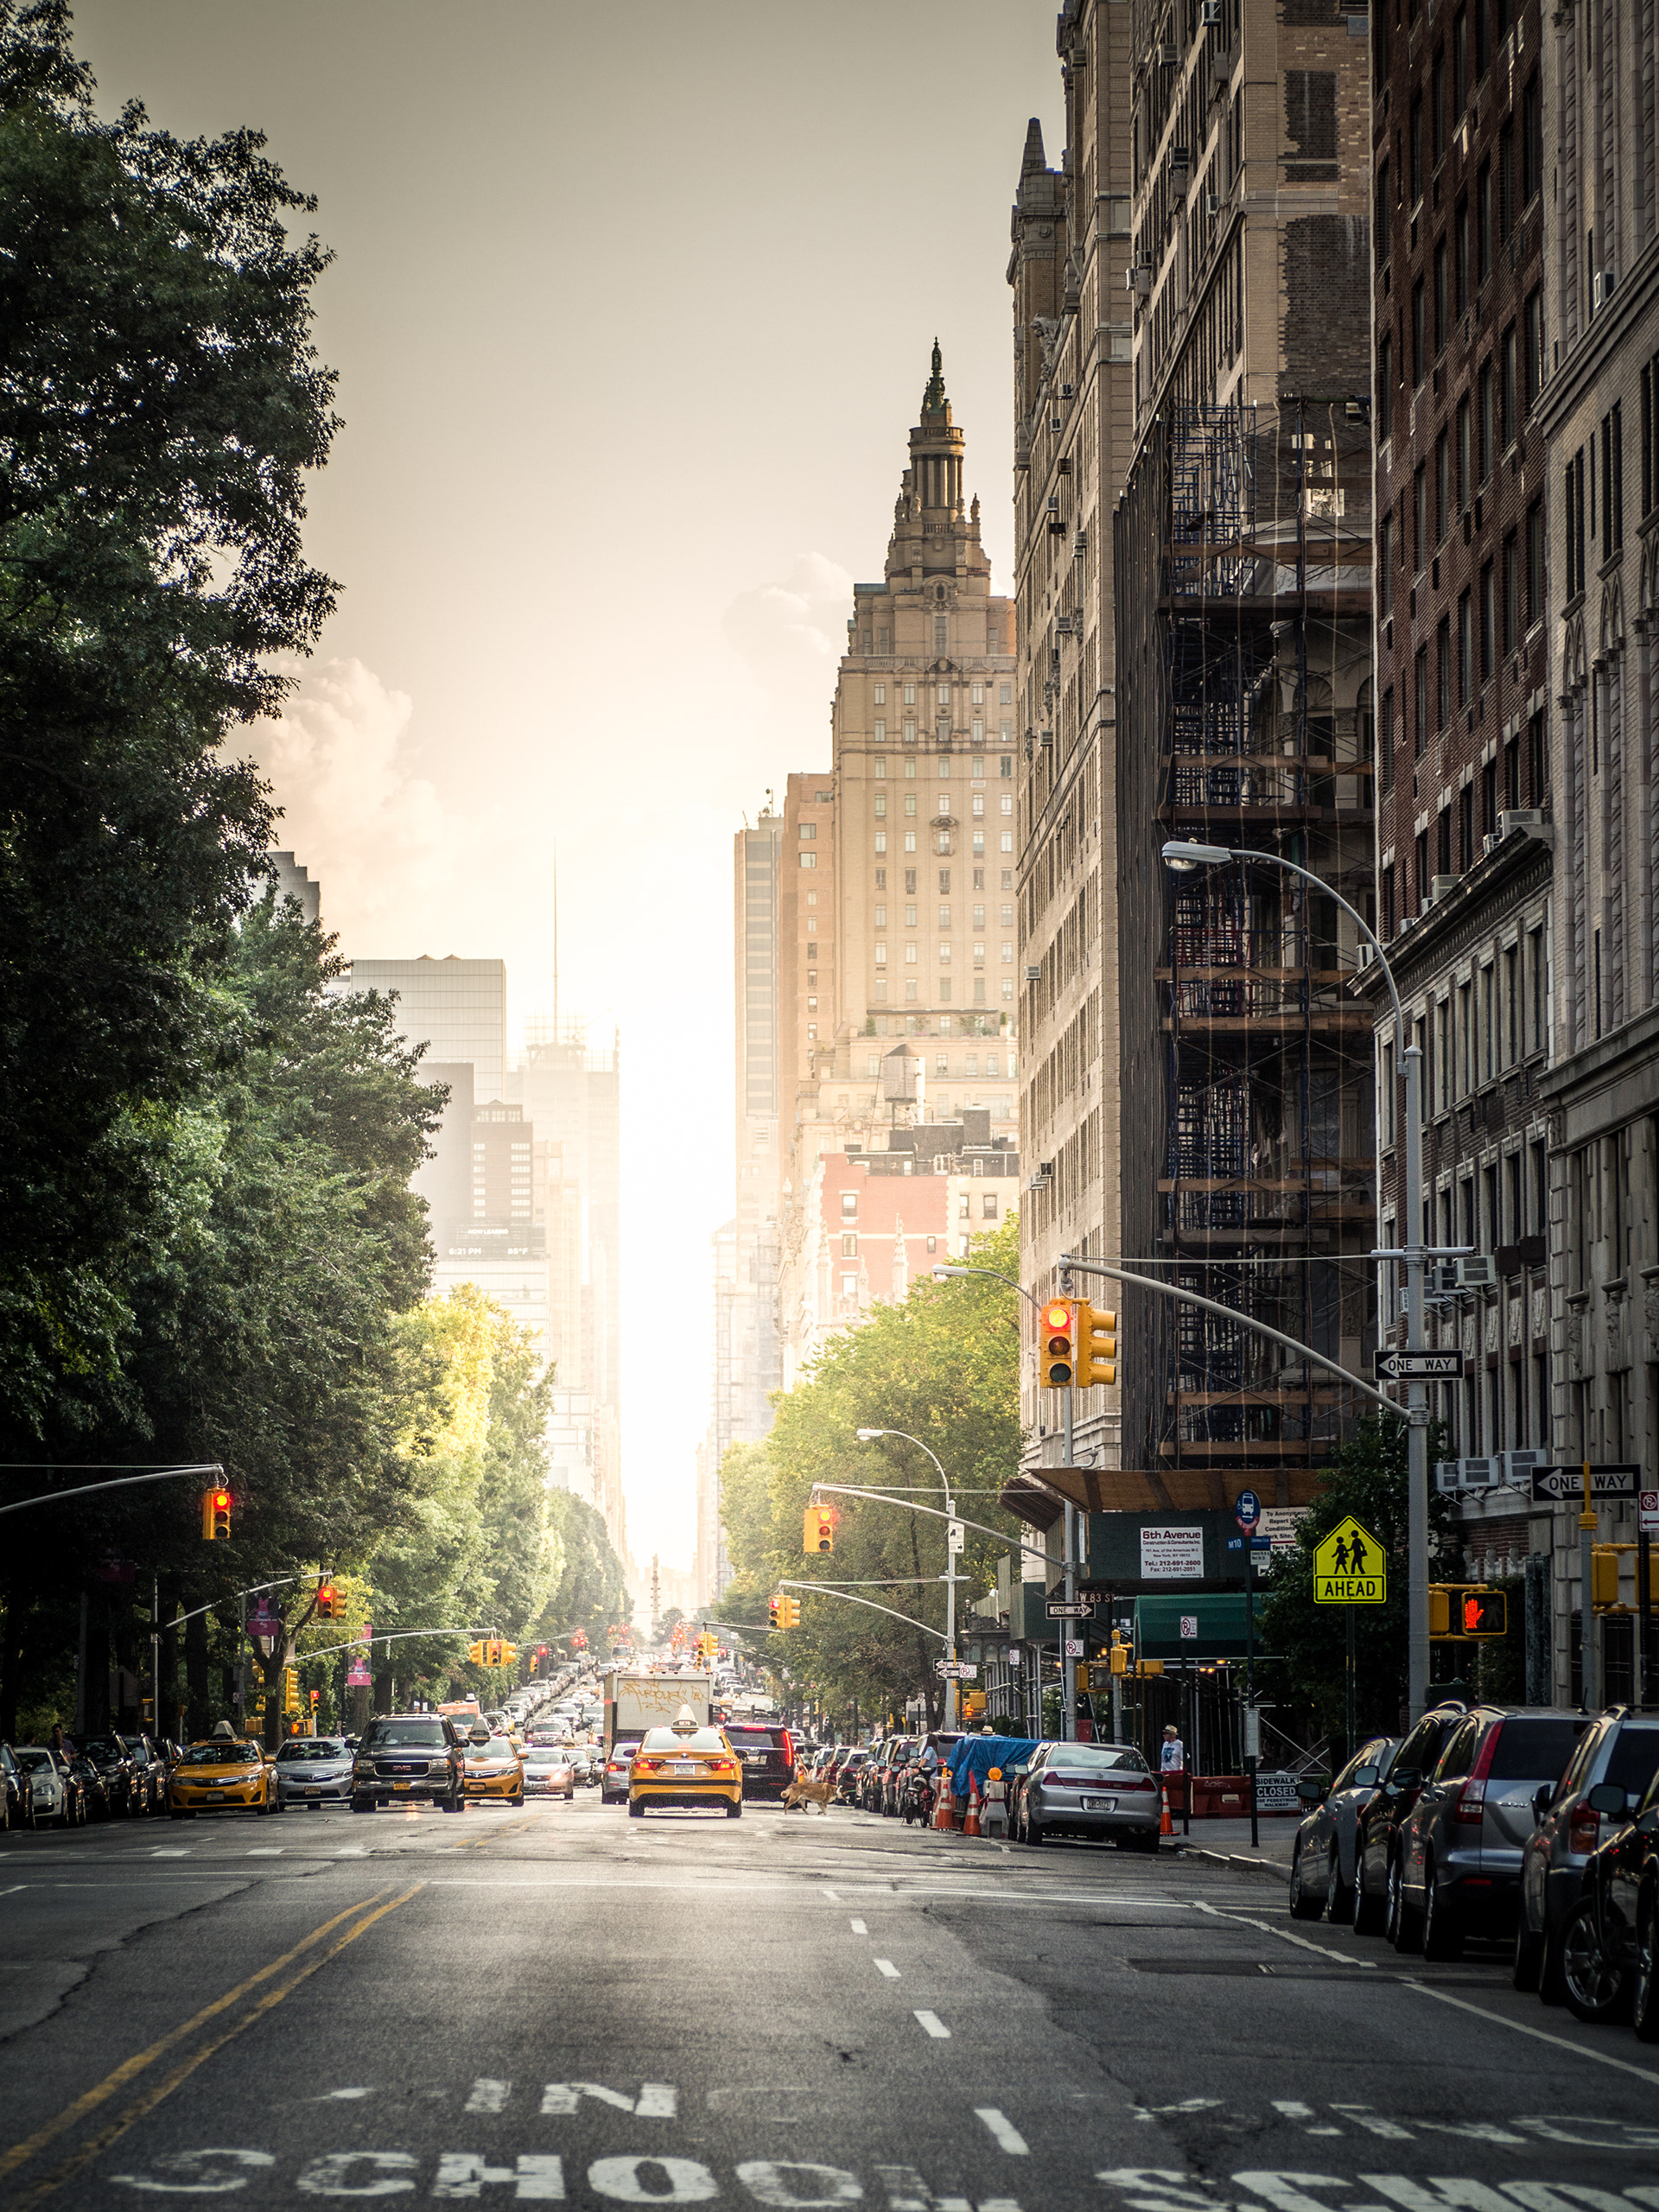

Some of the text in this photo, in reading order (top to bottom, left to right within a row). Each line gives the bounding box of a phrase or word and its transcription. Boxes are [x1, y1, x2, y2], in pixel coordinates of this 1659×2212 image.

[1388, 1359, 1451, 1371] ONE WAY
[1548, 1475, 1627, 1491] ONE WAY
[1142, 1530, 1201, 1539] 6th Avenue
[1228, 1539, 1242, 1548] M10
[1325, 1580, 1376, 1597] AHEAD
[1079, 1592, 1116, 1603] W 83 ST
[1255, 1777, 1296, 1785] SIDEWALK
[1256, 1786, 1296, 1796] CLOSED
